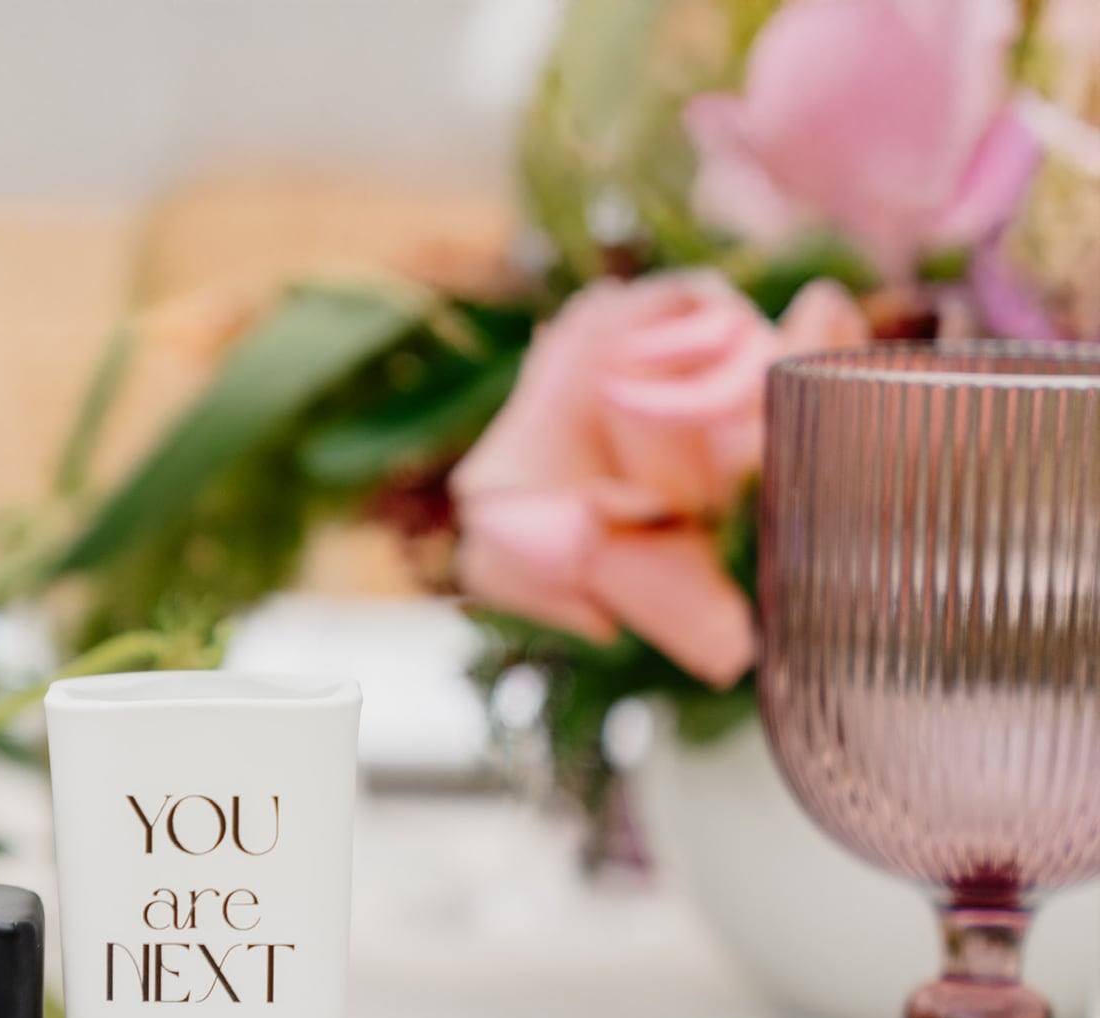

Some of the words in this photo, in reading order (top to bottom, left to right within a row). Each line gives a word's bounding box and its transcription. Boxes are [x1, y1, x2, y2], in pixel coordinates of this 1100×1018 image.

[125, 794, 281, 857] YOU
[142, 887, 262, 932] are
[104, 941, 297, 1005] NEXT
